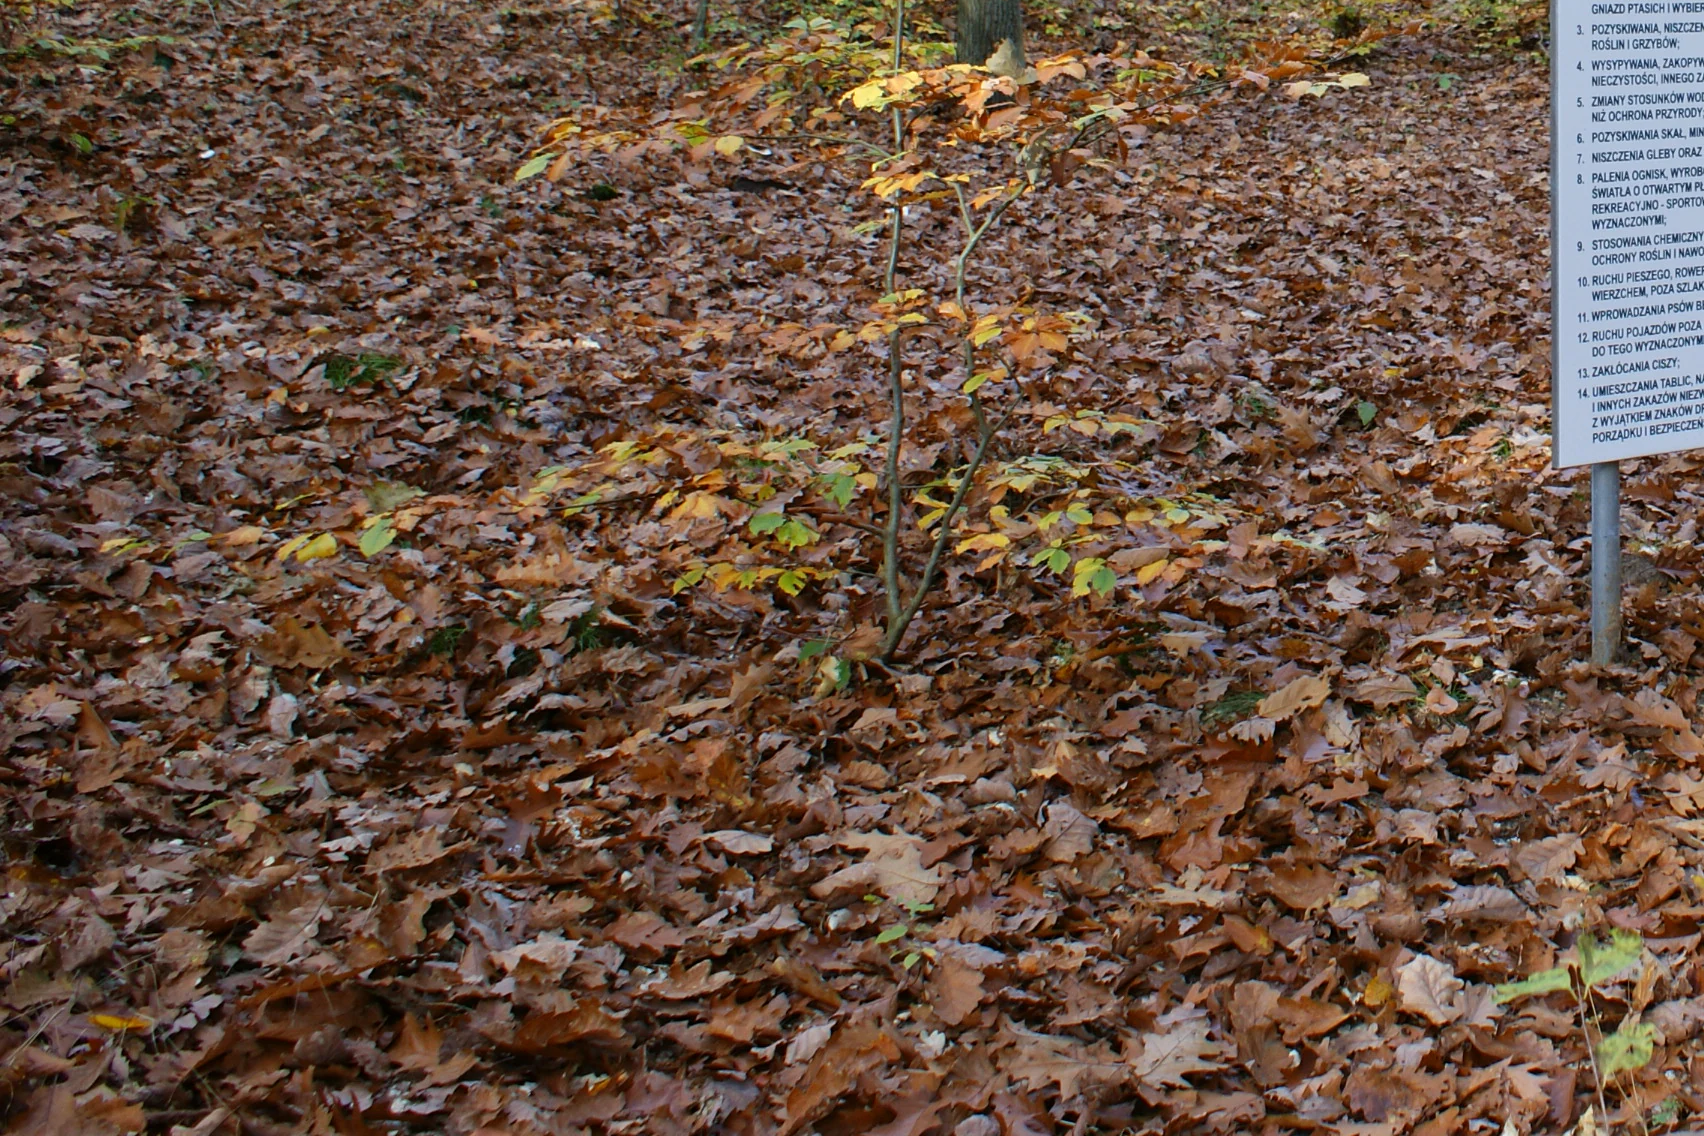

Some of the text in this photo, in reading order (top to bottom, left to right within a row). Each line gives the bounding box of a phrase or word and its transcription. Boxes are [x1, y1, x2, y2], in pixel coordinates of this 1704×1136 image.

[1591, 3, 1626, 14] GNIAZD
[1627, 2, 1665, 13] PTASICH
[1591, 23, 1662, 36] POZYSKIWANIA,
[1591, 35, 1680, 50] ROŚLIN GRZYBÓW;
[1590, 58, 1661, 73] WYSYPYWANIA,
[1591, 71, 1659, 86] NIECZYSTOŚCI,
[1660, 72, 1695, 84] INNEGO
[1590, 95, 1626, 107] ZMIANY
[1626, 90, 1685, 105] STOSUNKÓW
[1591, 107, 1704, 122] NIŻ OCHRONA PRZYRODY;
[1591, 129, 1659, 143] POZYSKIWANIA
[1660, 127, 1687, 139] SKAŁ,
[1591, 149, 1645, 163] NISZCZENIA
[1645, 148, 1676, 160] GLEBY
[1677, 146, 1702, 158] ORAZ
[1591, 170, 1630, 183] PALENIA
[1631, 168, 1668, 181] OGNISK,
[1591, 185, 1632, 199] ŚWIATŁA
[1641, 181, 1692, 195] OTWARTYM
[1591, 199, 1659, 215] REKREACYJNO
[1591, 214, 1666, 230] WYZNACZONYMI;
[1591, 235, 1652, 250] STOSOWANIA
[1591, 251, 1637, 266] OCHRONY
[1638, 247, 1671, 261] ROŚLIN
[1591, 273, 1624, 286] RUCHU
[1625, 268, 1673, 282] PIESZEGO,
[1591, 286, 1648, 301] WIERZCHEM,
[1650, 283, 1675, 295] POZA
[1590, 304, 1666, 321] WPROWADZANIA
[1667, 299, 1694, 313] PSÓW
[1591, 328, 1624, 341] RUCHU
[1625, 321, 1677, 338] POJAZDÓW
[1677, 320, 1702, 332] POZA
[1591, 345, 1606, 357] DO
[1607, 342, 1633, 355] TEGO
[1591, 357, 1680, 377] ZAKŁÓCANIA CISZY;
[1591, 379, 1659, 397] UMIESZCZANIA
[1596, 397, 1631, 412] INNYCH
[1632, 390, 1678, 407] ZAKAZÓW
[1599, 410, 1652, 427] WYJĄTKIEM
[1653, 403, 1693, 420] ZNAKÓW
[1592, 426, 1642, 443] PORZĄDKU
